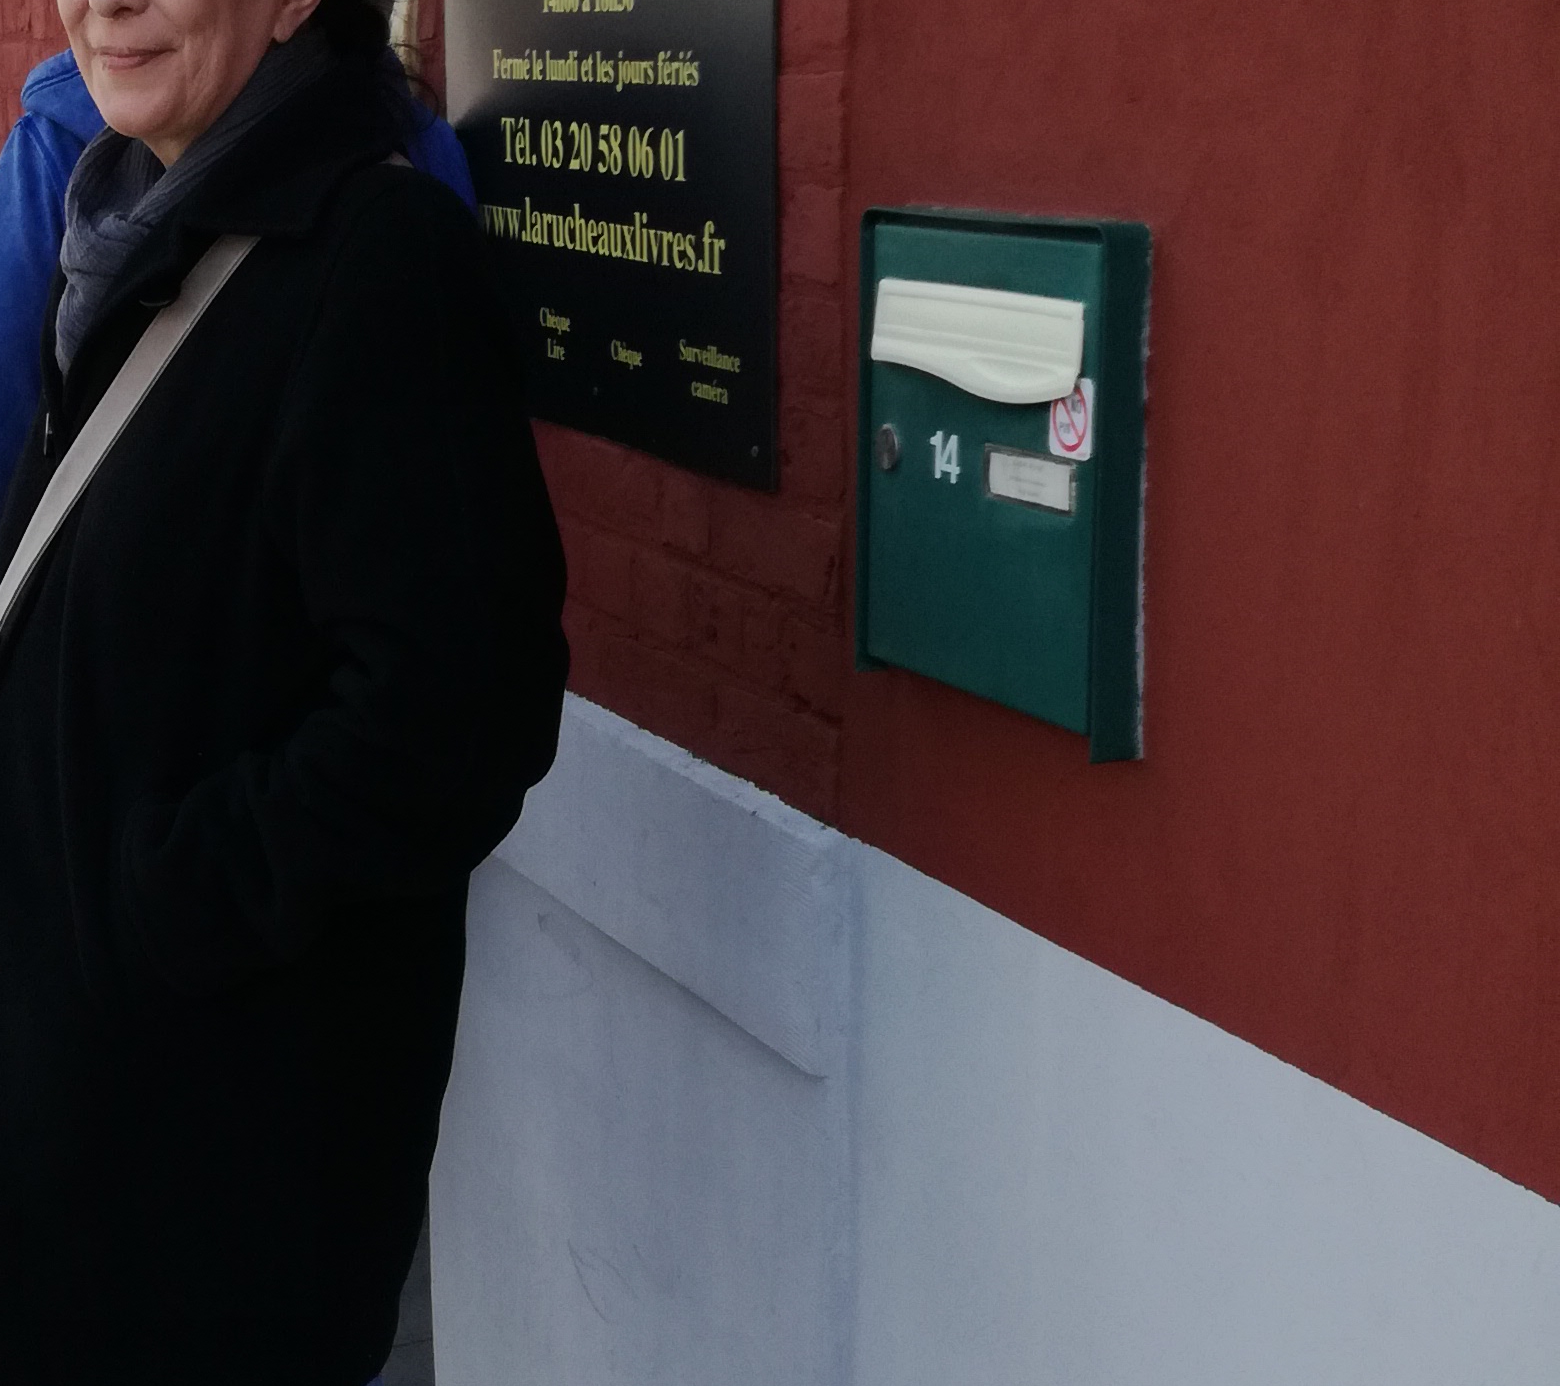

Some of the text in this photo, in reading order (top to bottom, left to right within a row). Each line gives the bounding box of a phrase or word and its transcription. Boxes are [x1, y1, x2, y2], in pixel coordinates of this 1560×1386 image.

[492, 48, 700, 93] Fermé le lundi et les jours fériés
[501, 116, 687, 182] Tél. 03 20 58 06 01
[539, 306, 571, 335] Chèque
[547, 337, 566, 361] Lire
[610, 338, 643, 370] Chèque
[678, 338, 741, 373] Surveillance
[690, 379, 729, 405] caméra
[929, 430, 961, 484] 14
